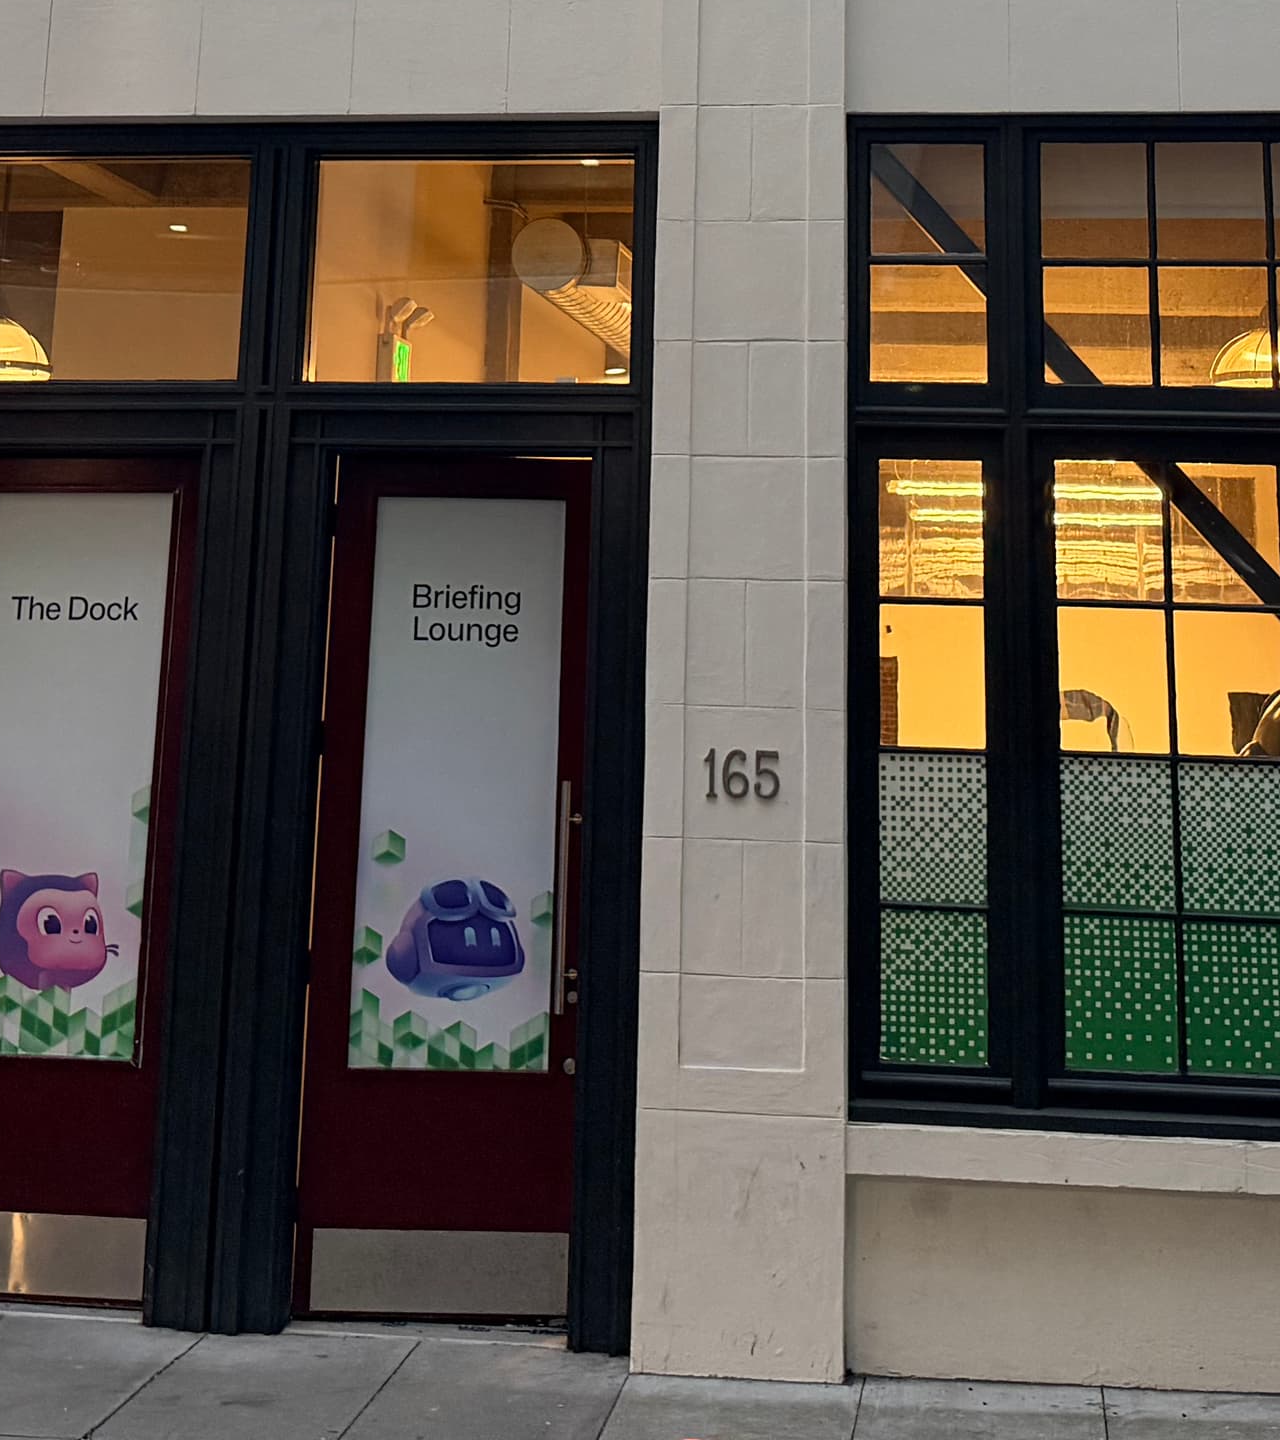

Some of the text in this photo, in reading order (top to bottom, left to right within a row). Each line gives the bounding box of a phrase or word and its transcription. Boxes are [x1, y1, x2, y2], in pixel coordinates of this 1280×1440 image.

[11, 596, 139, 621] The Dock
[413, 583, 521, 615] Briefing
[413, 616, 519, 647] Lounge
[703, 748, 780, 800] 165
